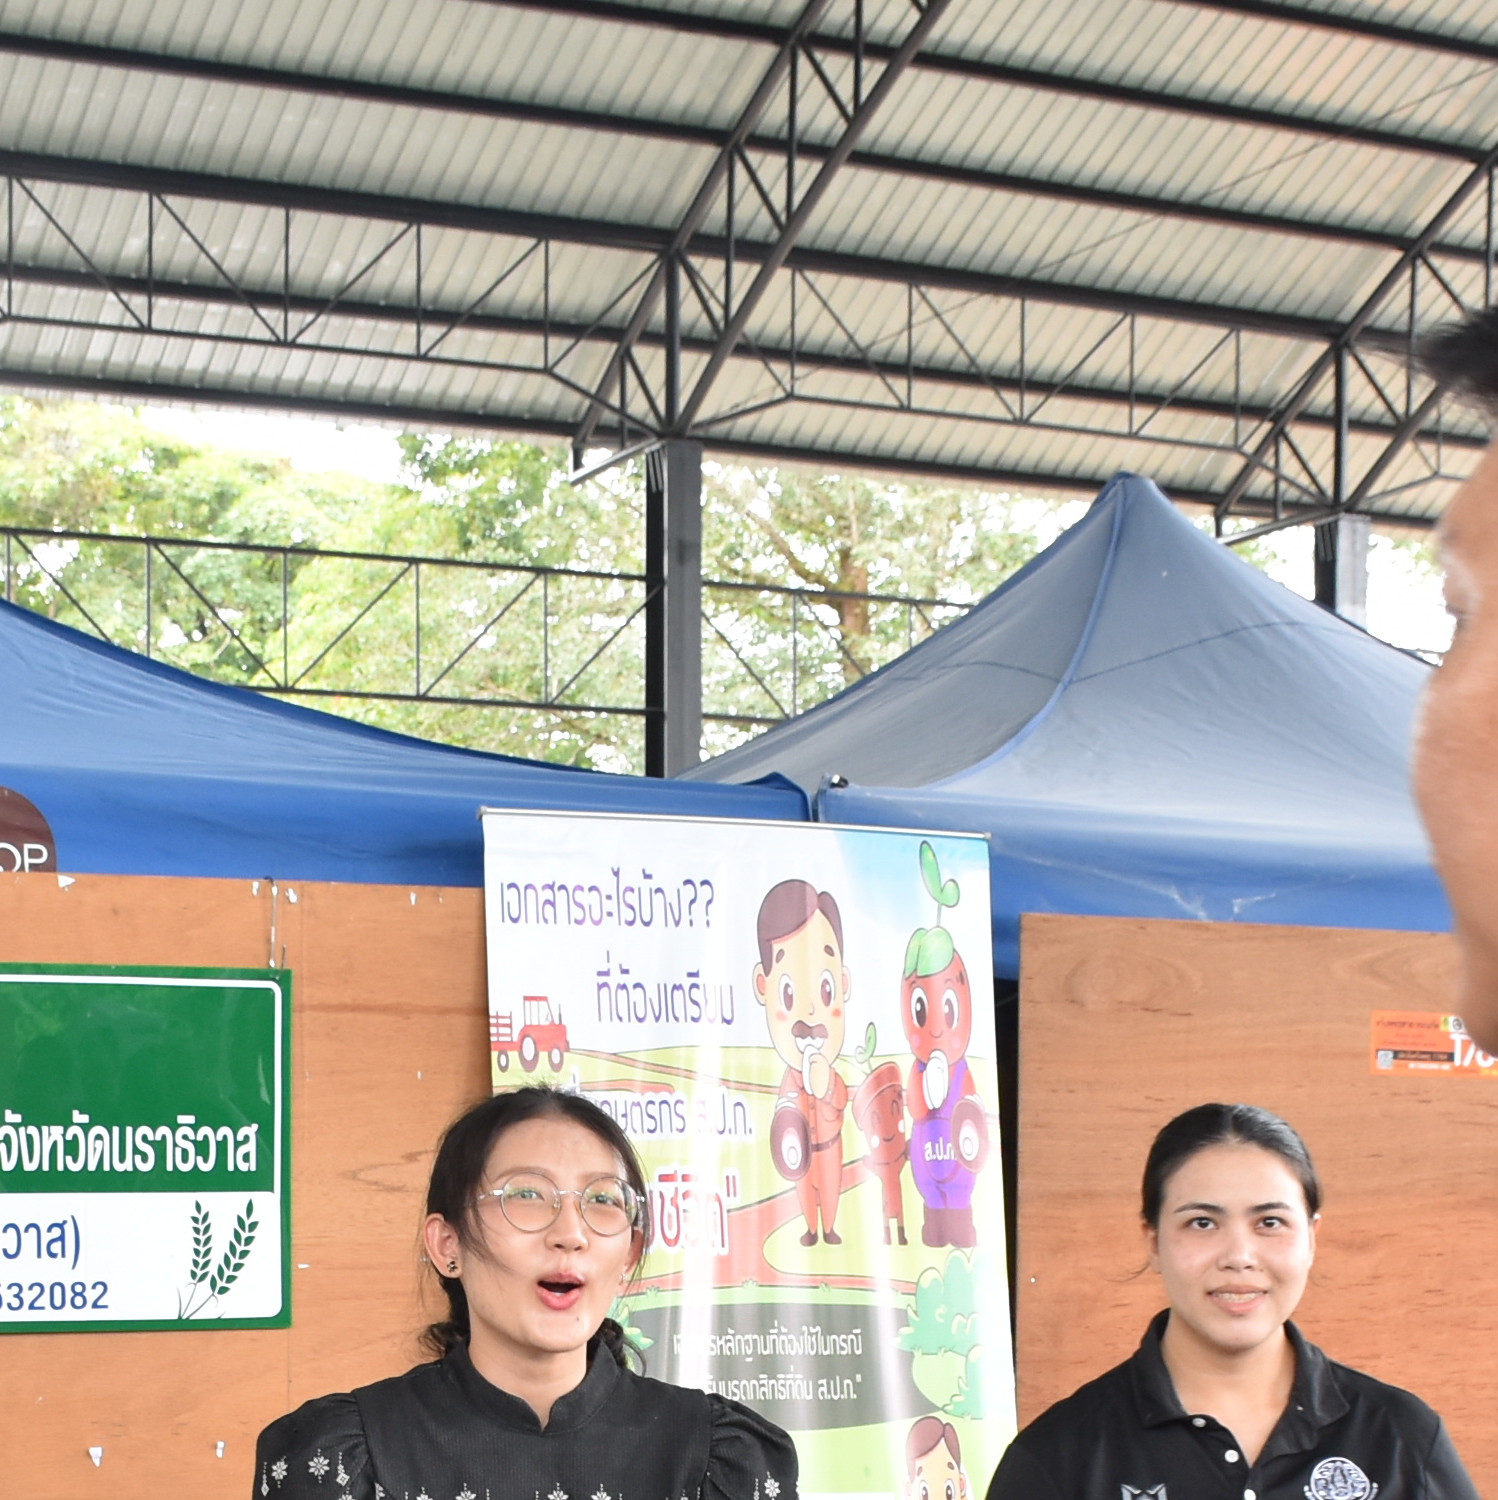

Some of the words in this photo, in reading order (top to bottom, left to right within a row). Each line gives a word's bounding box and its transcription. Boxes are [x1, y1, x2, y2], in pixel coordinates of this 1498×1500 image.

[500, 866, 715, 928] เอกสารอะไรบ้าง??
[595, 949, 735, 1026] ที่ต้องเตรียม
